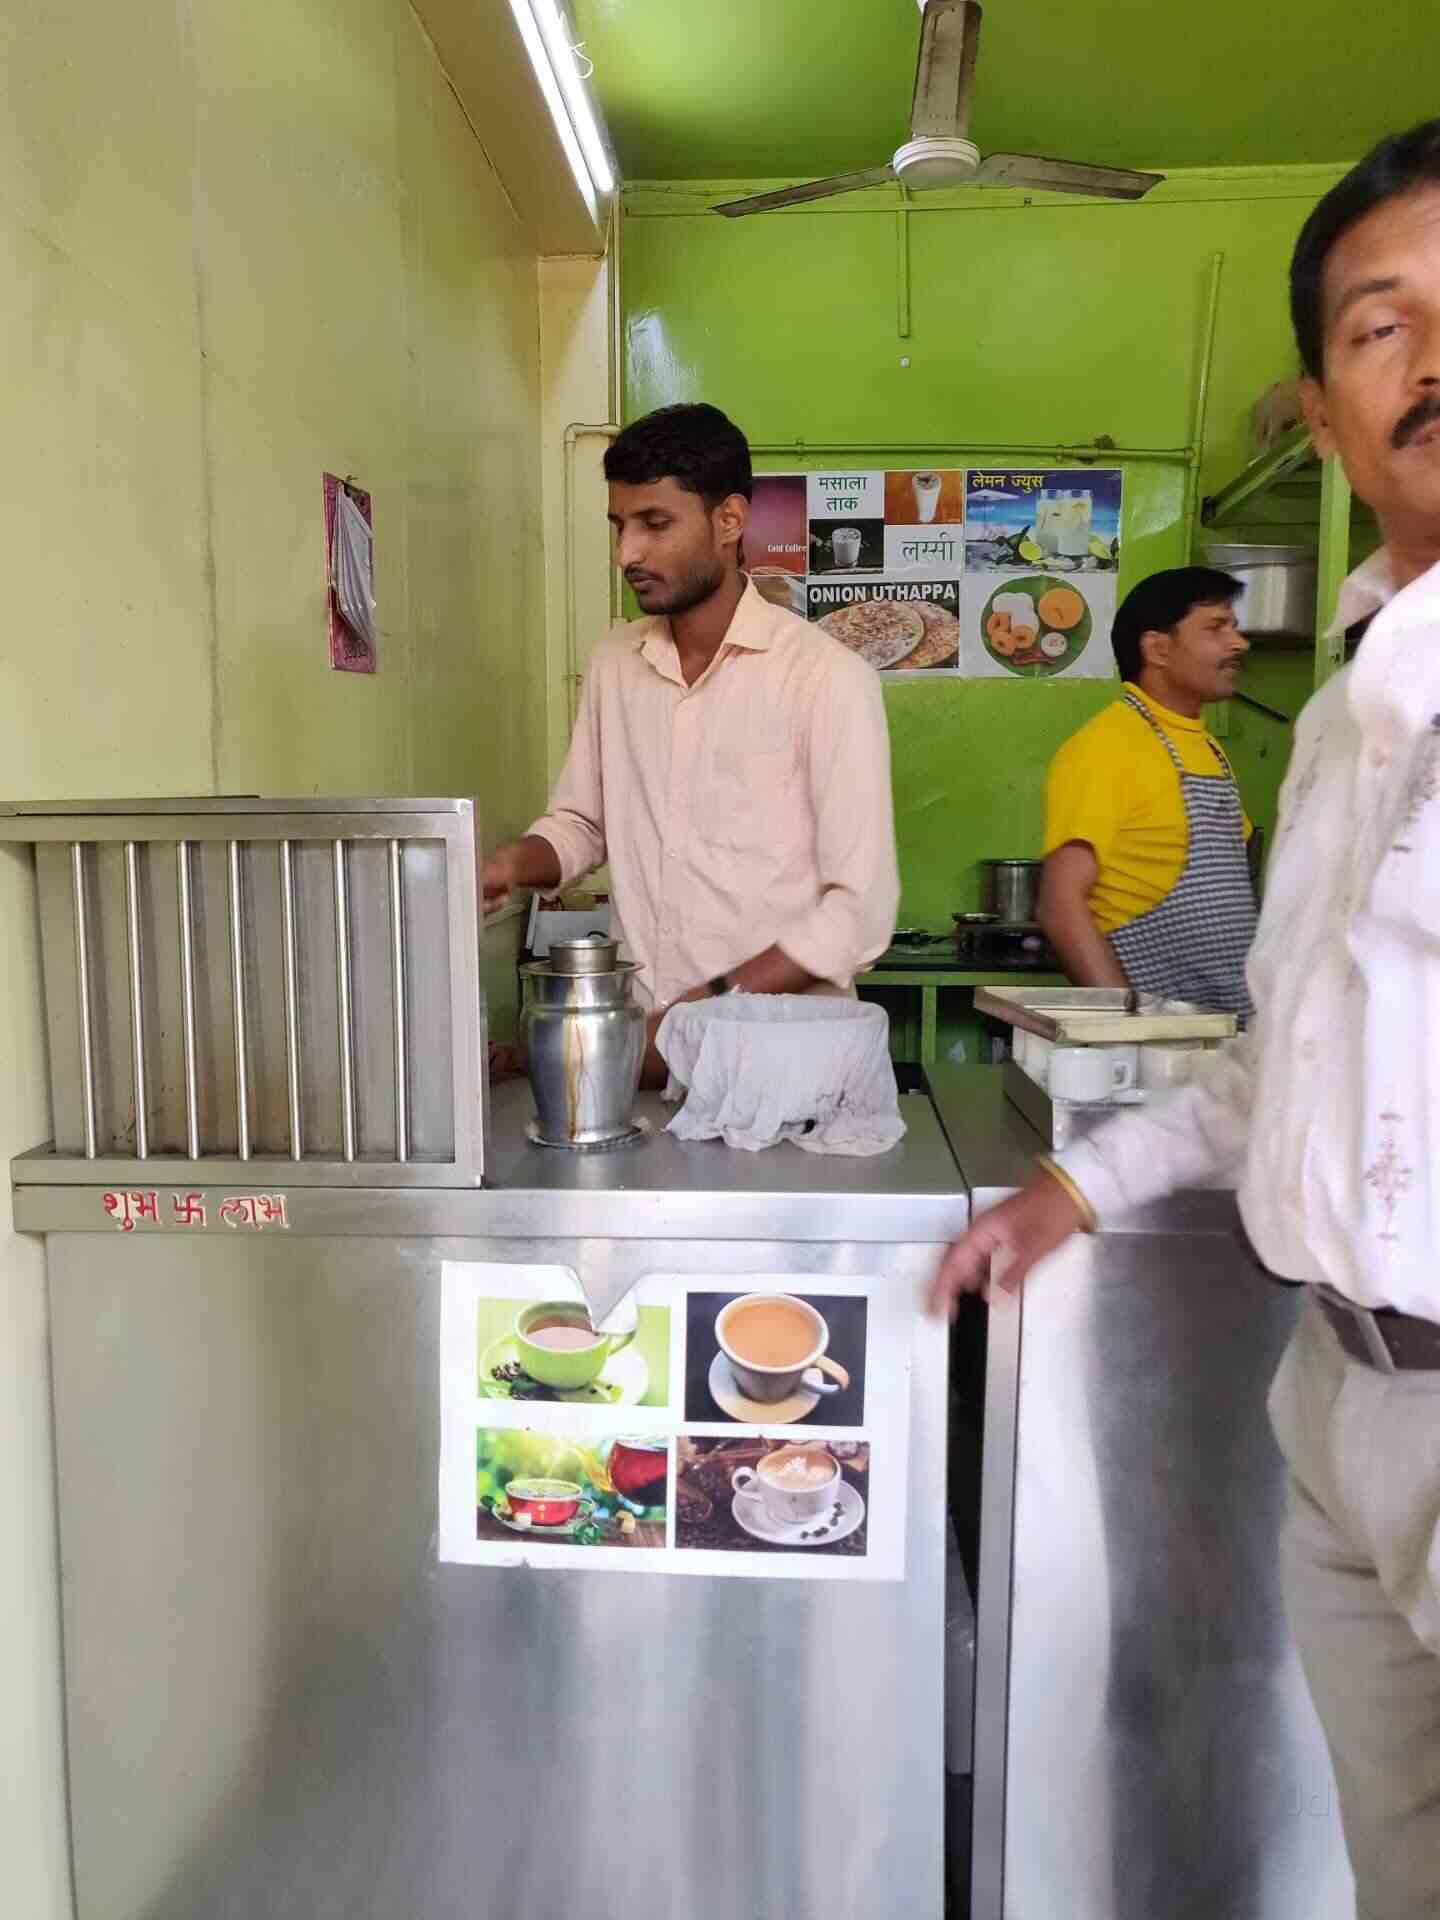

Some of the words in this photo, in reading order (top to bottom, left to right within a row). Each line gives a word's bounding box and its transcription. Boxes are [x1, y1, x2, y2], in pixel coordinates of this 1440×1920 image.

[818, 477, 868, 491] मसाला
[971, 472, 1006, 488] लेमन
[825, 497, 861, 512] ताक
[809, 585, 866, 603] ONION
[872, 583, 956, 602] UTHAPPA
[103, 1191, 161, 1231] शुभ
